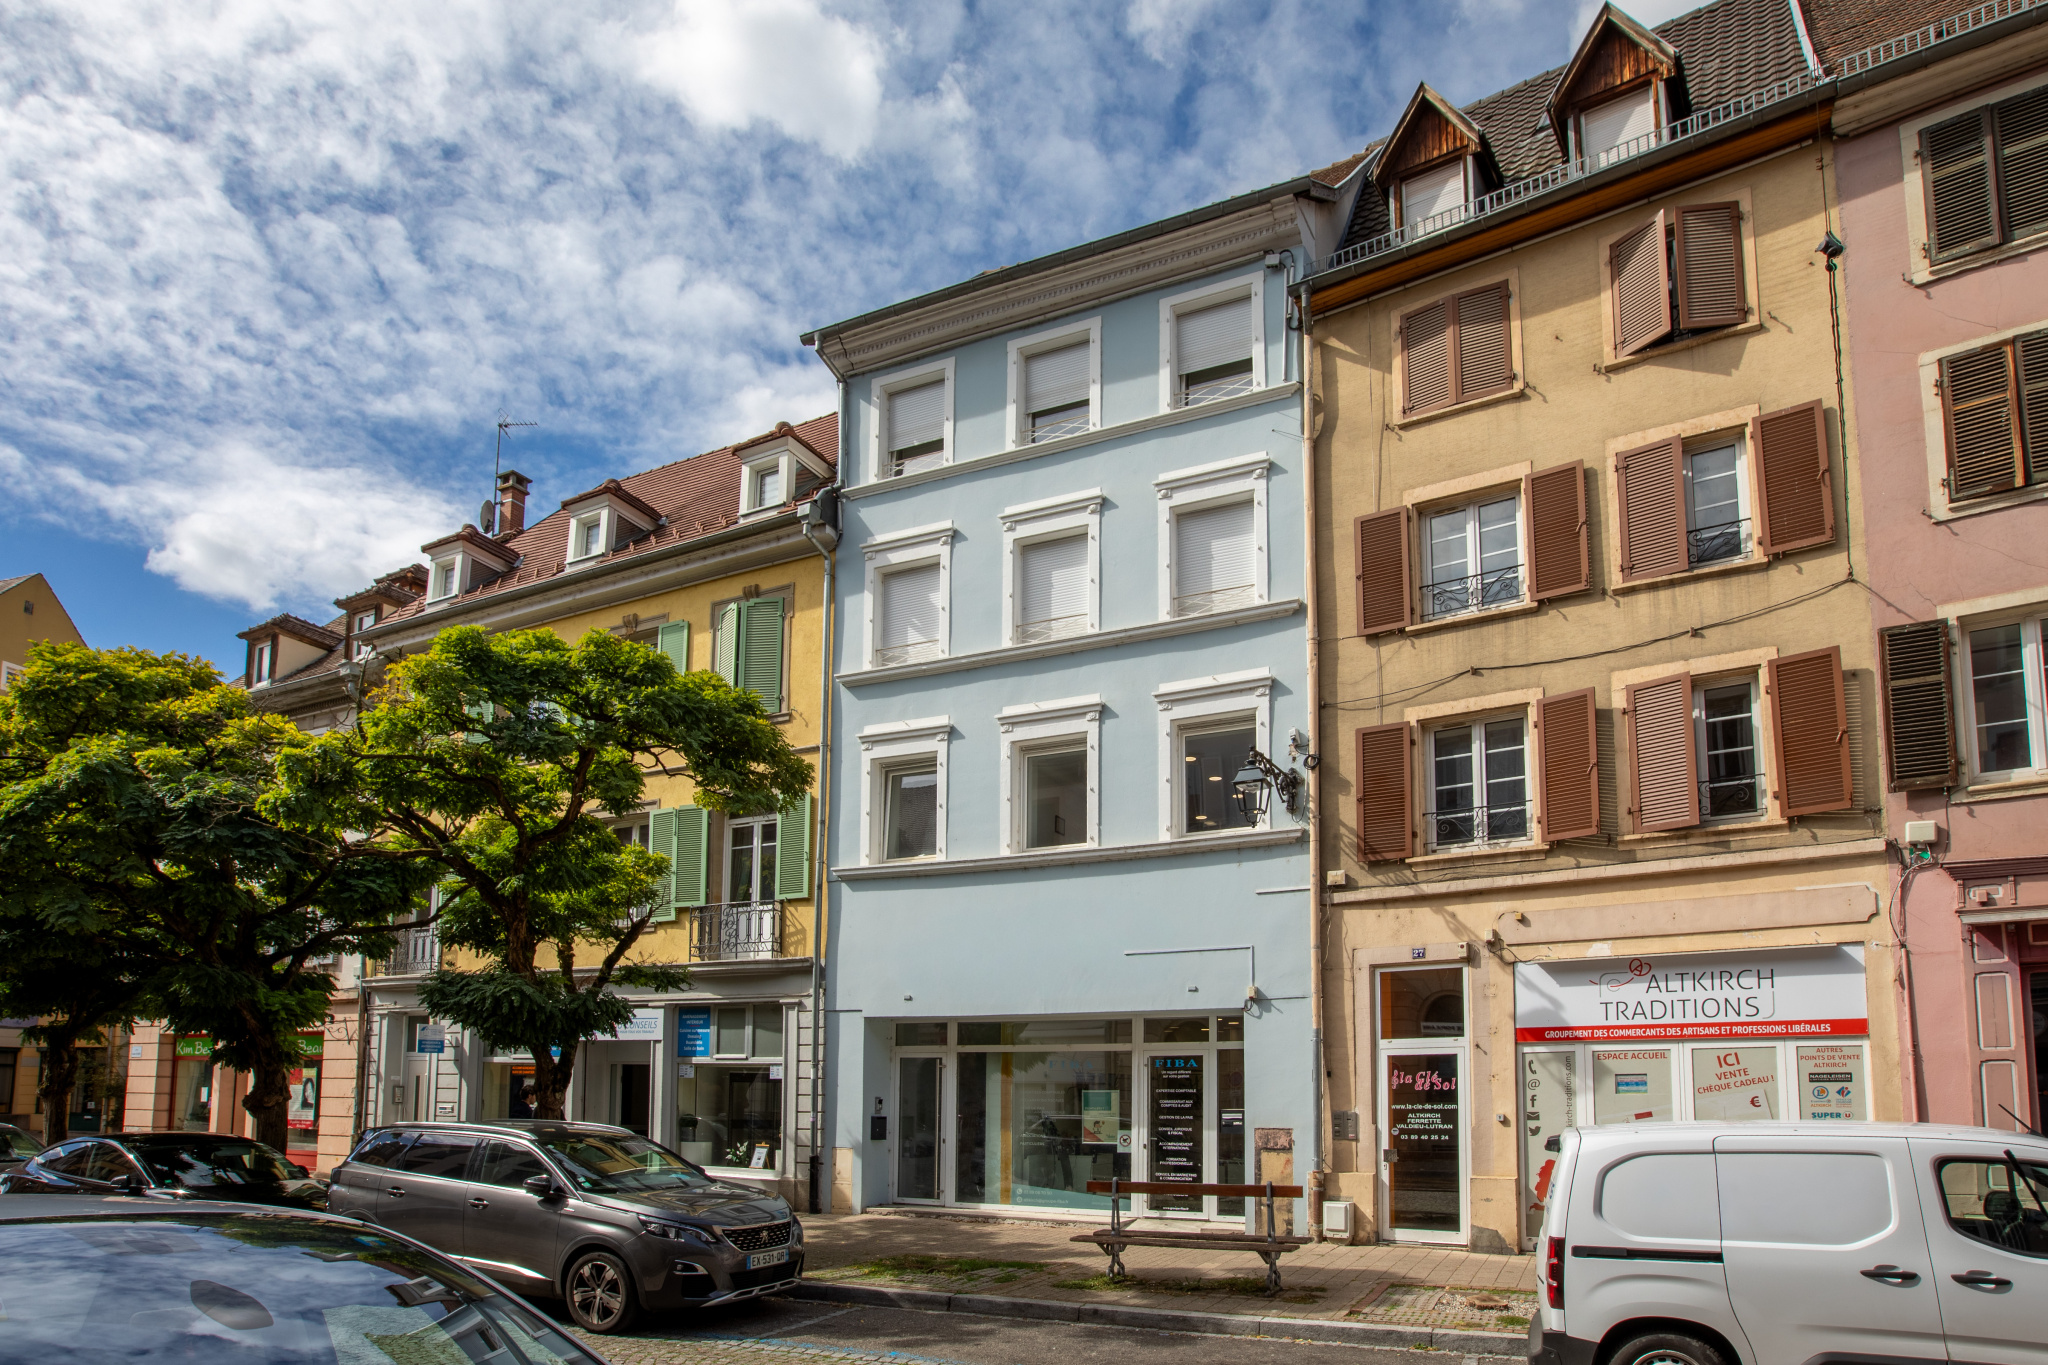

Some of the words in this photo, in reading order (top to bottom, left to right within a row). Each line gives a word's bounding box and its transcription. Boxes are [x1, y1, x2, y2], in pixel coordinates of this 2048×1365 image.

[1646, 968, 1775, 994] ALTKIRCH
[1600, 996, 1760, 1021] TRADITIONS
[1545, 1029, 1592, 1038] GROUPEMENT
[1609, 1028, 1665, 1037] COMMERCANTS
[1682, 1026, 1720, 1035] ARTISANS
[1732, 1025, 1786, 1033] PROFESSIONS
[1788, 1023, 1830, 1032] LIBÉRALES
[176, 1042, 193, 1054] Kim
[1597, 1052, 1628, 1060] ESPACE
[1717, 1052, 1740, 1068] ICI
[1155, 1059, 1198, 1067] FIBA
[1400, 1072, 1412, 1083] la
[1416, 1071, 1438, 1083] Clé
[1715, 1068, 1749, 1080] VENTE
[1415, 1078, 1430, 1090] de
[1434, 1078, 1456, 1090] Sol
[1697, 1082, 1732, 1094] CHÈQUE
[1734, 1076, 1769, 1088] CADEAU
